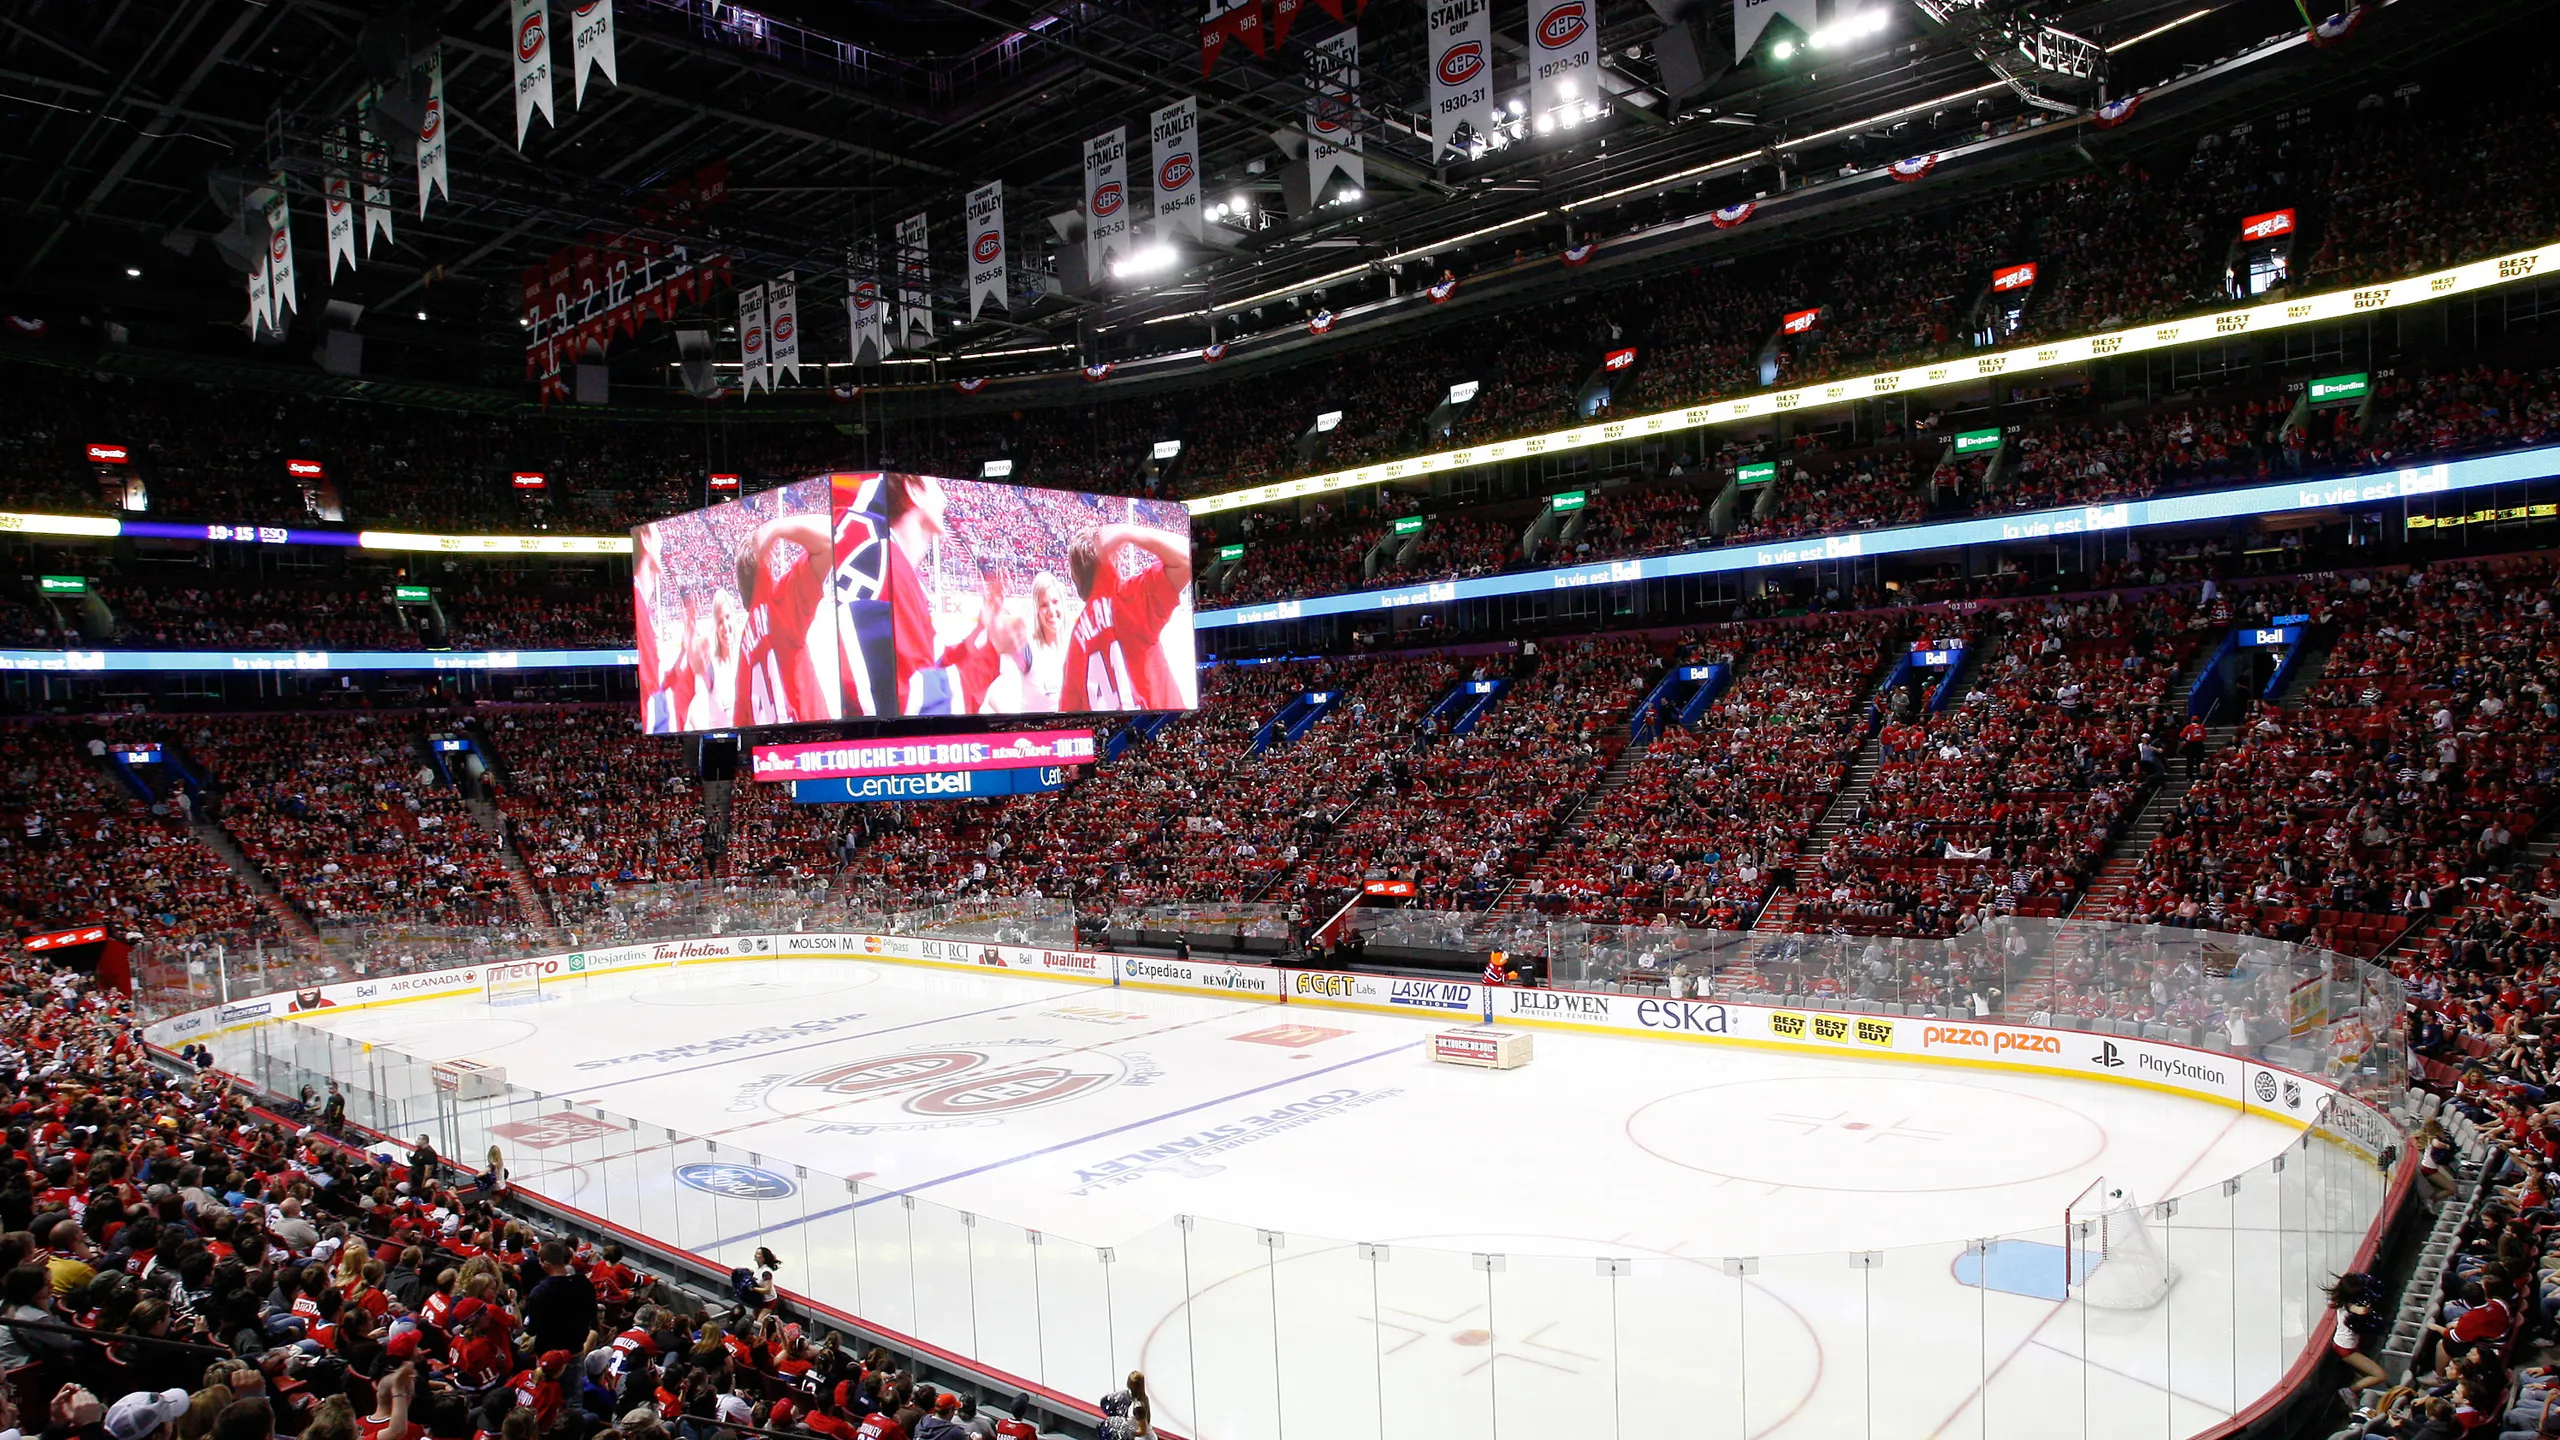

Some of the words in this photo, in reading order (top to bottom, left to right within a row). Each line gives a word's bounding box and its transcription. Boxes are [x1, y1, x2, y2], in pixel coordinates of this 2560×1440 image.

[1278, 0, 1297, 14] 1963
[1431, 0, 1486, 30] STANLEY
[1239, 14, 1257, 32] 1975
[1450, 21, 1469, 35] CUP
[577, 17, 606, 50] 1972-73
[1203, 31, 1220, 48] 1955
[1538, 51, 1589, 80] 1929-30
[519, 64, 546, 94] 1975-76
[1440, 87, 1485, 114] 1930-31
[1162, 104, 1185, 121] COUPE
[1154, 112, 1195, 143] STANLEY
[1094, 134, 1116, 150] COUPE
[1168, 136, 1182, 149] CUP
[1087, 142, 1125, 171] STANLEY
[1100, 164, 1112, 176] CUP
[974, 188, 993, 202] COUPE
[968, 194, 1001, 221] STANLEY
[1160, 194, 1196, 216] 1945-46
[980, 215, 991, 226] CUP
[1093, 220, 1125, 240] 1952-53
[2499, 255, 2539, 269] BEST
[974, 266, 1003, 285] 1955-56
[2500, 266, 2533, 278] BUY
[606, 260, 629, 308] 12
[2431, 276, 2457, 285] BEST
[2432, 283, 2454, 292] BUY
[583, 278, 596, 320] 2
[770, 286, 795, 304] STANLEY
[2354, 289, 2391, 300] BEST
[740, 297, 763, 316] STANLEY
[2288, 304, 2312, 313] BEST
[2354, 298, 2386, 309] BUY
[556, 293, 568, 335] 9
[2216, 314, 2250, 325] BEST
[2288, 310, 2309, 318] BUY
[529, 305, 541, 347] 7
[2217, 322, 2247, 333] BUY
[2092, 337, 2123, 347] BEST
[2093, 345, 2120, 354] BUY
[1978, 357, 2007, 367] BEST
[1979, 365, 2004, 373] BUY
[1873, 376, 1900, 386] BEST
[2377, 368, 2395, 379] 204
[1452, 384, 1480, 399] metro
[1874, 383, 1898, 391] BUY
[2288, 382, 2304, 392] 203
[2325, 381, 2365, 393] Desjardins
[1776, 393, 1800, 402] BEST
[1776, 400, 1798, 408] BUY
[1319, 415, 1342, 427] metro
[1687, 410, 1709, 419] BEST
[1687, 416, 1707, 424] BUY
[2007, 425, 2021, 434] 203
[1938, 435, 1952, 444] 202
[1967, 434, 1998, 446] Desjardins
[90, 447, 126, 459] Saputo
[1156, 446, 1179, 456] metro
[986, 465, 1011, 473] metro
[1747, 469, 1774, 478] Desjardins
[711, 475, 737, 486] Saputo
[2300, 490, 2318, 507] la
[2324, 486, 2357, 505] vie
[2362, 481, 2396, 499] est
[2401, 464, 2449, 495] Bell
[2003, 523, 2019, 541] la
[2022, 519, 2049, 537] vie
[2053, 516, 2082, 534] est
[2086, 504, 2128, 531] Bell
[1758, 551, 1772, 565] la
[1774, 548, 1797, 563] vie
[1800, 546, 1824, 560] est
[1826, 534, 1861, 558] Bell
[1568, 573, 1587, 586] vie
[1590, 571, 1609, 584] est
[1612, 559, 1641, 582] Bell
[1393, 593, 1409, 606] vie
[1411, 592, 1428, 604] est
[1430, 582, 1455, 602] Bell
[2256, 628, 2284, 645] Bell
[1925, 651, 1947, 666] Bell
[1690, 666, 1709, 680] Bell
[1475, 681, 1492, 694] Bell
[1312, 692, 1327, 704] Bell
[443, 740, 460, 750] Bell
[128, 751, 149, 764] Bell
[800, 752, 822, 772] ON
[826, 748, 898, 771] TOUCHE
[904, 747, 931, 767] DU
[937, 743, 982, 765] BOIS
[846, 771, 971, 797] CentreBell
[653, 944, 677, 961] Tim
[679, 941, 730, 958] Hortons
[788, 937, 836, 950] MOLSON
[843, 937, 854, 951] M
[921, 941, 942, 956] RCI
[948, 943, 969, 959] RCI
[588, 950, 647, 966] Desjardins
[1019, 953, 1033, 965] Bell
[1043, 950, 1098, 970] Qualinet
[489, 961, 558, 982] metro
[1138, 961, 1193, 981] Expedia.ca
[390, 980, 411, 991] AIR
[413, 973, 461, 990] CANADA
[1203, 973, 1228, 988] RÉNO
[1236, 974, 1267, 992] DÉPÔT
[1296, 972, 1356, 997] AGAT
[1356, 982, 1377, 995] Labs
[357, 983, 378, 998] Bell
[1391, 980, 1439, 1000] LASIK
[1442, 985, 1472, 1001] MD
[1408, 1000, 1449, 1008] VISION
[1520, 1009, 1550, 1018] PORTES
[1567, 1011, 1609, 1021] FENÊTRES
[1637, 999, 1728, 1034] eska
[1773, 1013, 1805, 1027] BEST
[1774, 1024, 1802, 1036] BUY
[1815, 1017, 1848, 1031] BEST
[1858, 1020, 1892, 1035] BEST
[1816, 1027, 1844, 1039] BUY
[1859, 1031, 1888, 1043] BUY
[1924, 1026, 1988, 1047] pizza
[1994, 1030, 2061, 1054] pizza
[653, 1024, 840, 1063] PLAYOFFS
[574, 1033, 752, 1071] STANLEY
[2139, 1053, 2226, 1086] PlayStation
[725, 1073, 791, 1113] CentreBell
[1250, 1089, 1361, 1127] COUPE
[1197, 1108, 1339, 1158] ÉLIMINATOIRES
[1073, 1124, 1247, 1184] STANLEY
[688, 1167, 778, 1196] Ford
[479, 1367, 495, 1383] 11
